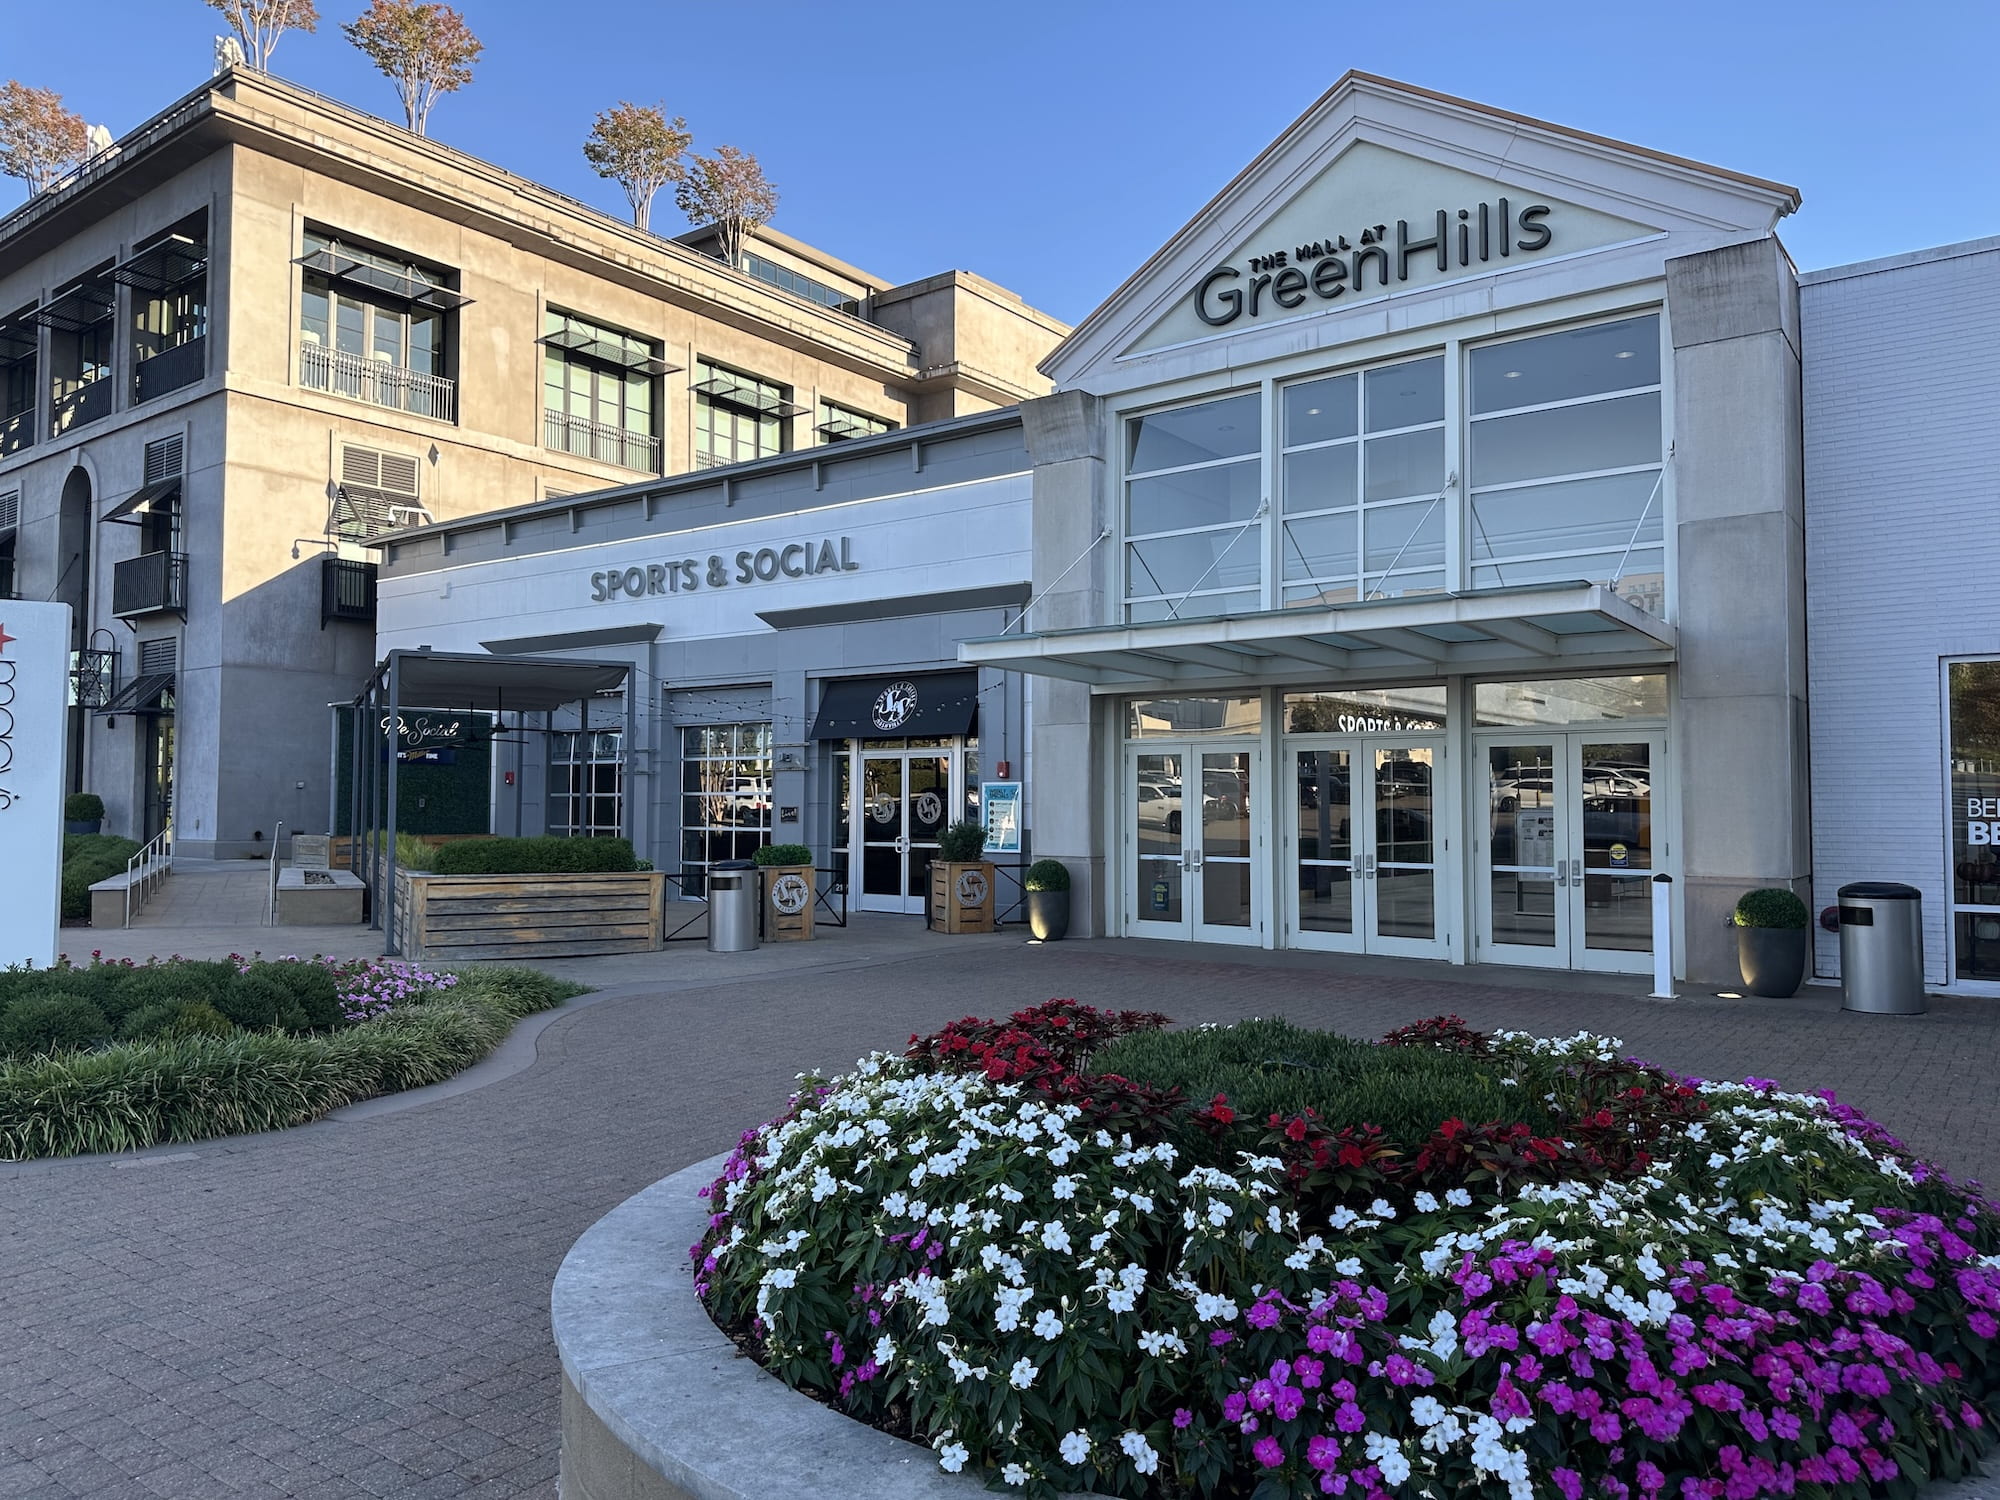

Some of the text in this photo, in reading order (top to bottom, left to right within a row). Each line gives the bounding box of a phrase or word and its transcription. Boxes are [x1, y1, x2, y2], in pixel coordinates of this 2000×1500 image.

[1248, 224, 1387, 273] THE MALL AT
[591, 536, 860, 602] SPORTS & SOCIAL
[407, 718, 460, 745] Social
[1968, 798, 2000, 818] BE
